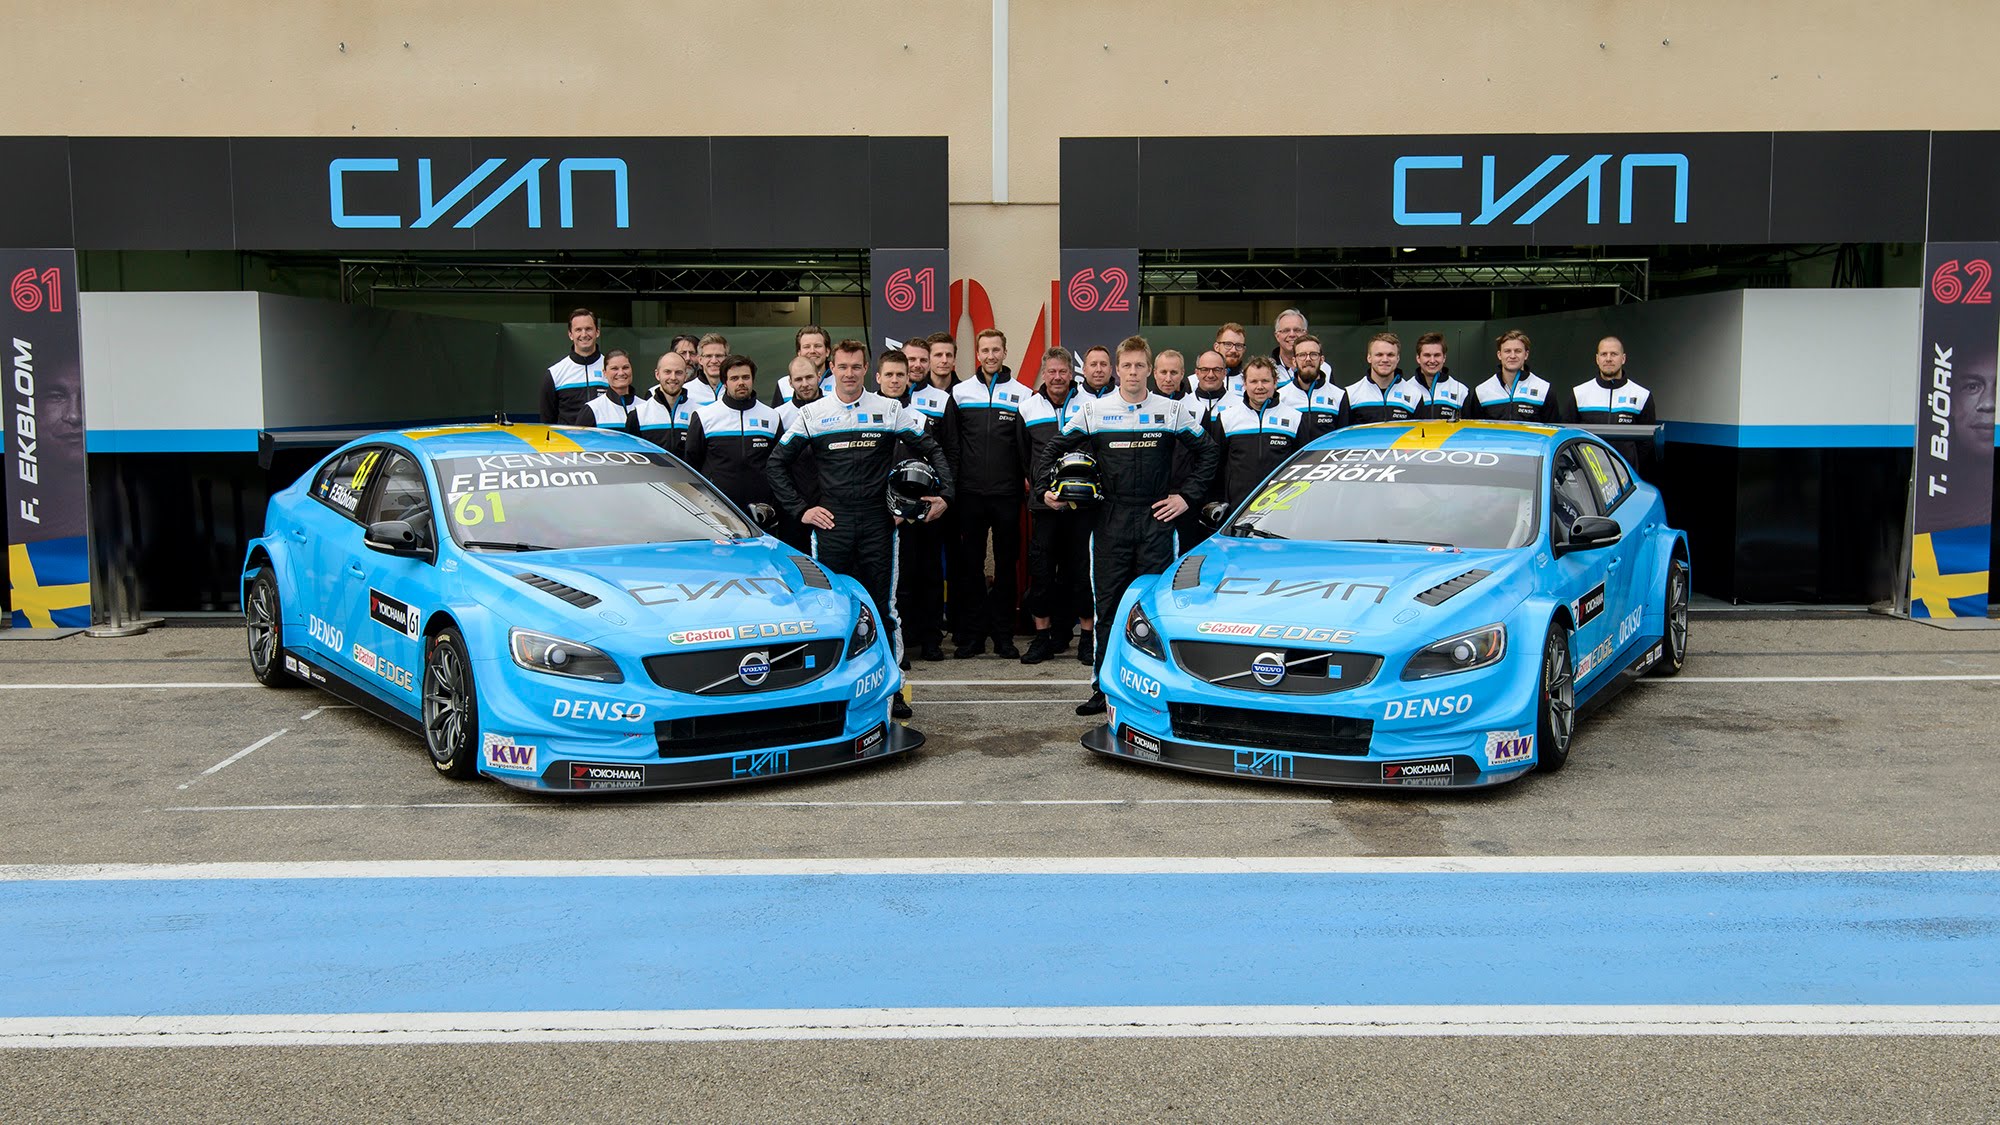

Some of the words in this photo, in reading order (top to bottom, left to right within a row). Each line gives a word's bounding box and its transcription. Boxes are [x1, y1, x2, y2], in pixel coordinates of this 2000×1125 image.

[329, 158, 629, 229] CYAN
[1393, 153, 1689, 226] CYAN
[10, 267, 62, 312] 61
[885, 267, 935, 312] 61
[1068, 267, 1130, 312] 62
[1931, 259, 1993, 304] 62
[13, 338, 38, 485] EKBLOM
[1927, 343, 1953, 462] BJÖRK
[849, 440, 877, 448] EDGE
[1131, 440, 1157, 448] EDGE
[351, 451, 379, 490] 61
[476, 452, 651, 471] KENWOOD
[1321, 449, 1500, 467] KENWOOD
[1582, 446, 1608, 485] 62
[450, 469, 598, 493] F.Ekblom
[1280, 463, 1406, 482] T.Björk
[1928, 472, 1950, 498] T.
[454, 492, 506, 526] 61
[1250, 481, 1311, 512] 62
[20, 498, 40, 525] F.
[628, 577, 795, 606] CYAN
[1213, 577, 1390, 604] CYAN
[378, 602, 406, 625] YOKOHAMA
[409, 611, 419, 636] 61
[1619, 604, 1642, 645] DENSO
[309, 614, 343, 653] DENSO
[686, 629, 732, 642] Castrol
[737, 620, 818, 640] EDGE
[1211, 623, 1257, 635] Castrol
[1258, 625, 1360, 645] EDGE
[1591, 634, 1614, 668] EDGE
[377, 656, 413, 692] EDGE
[742, 665, 769, 673] VOLVO
[1120, 666, 1161, 699] DENSO
[1255, 665, 1282, 673] VOLVO
[552, 698, 646, 723] DENSO
[1383, 694, 1473, 721] DENSO
[492, 744, 534, 765] KW
[1133, 736, 1159, 753] YOKOHAMA
[1495, 736, 1533, 759] KW
[589, 768, 641, 780] YOKOHAMA
[1400, 762, 1451, 776] YOKOHAMA
